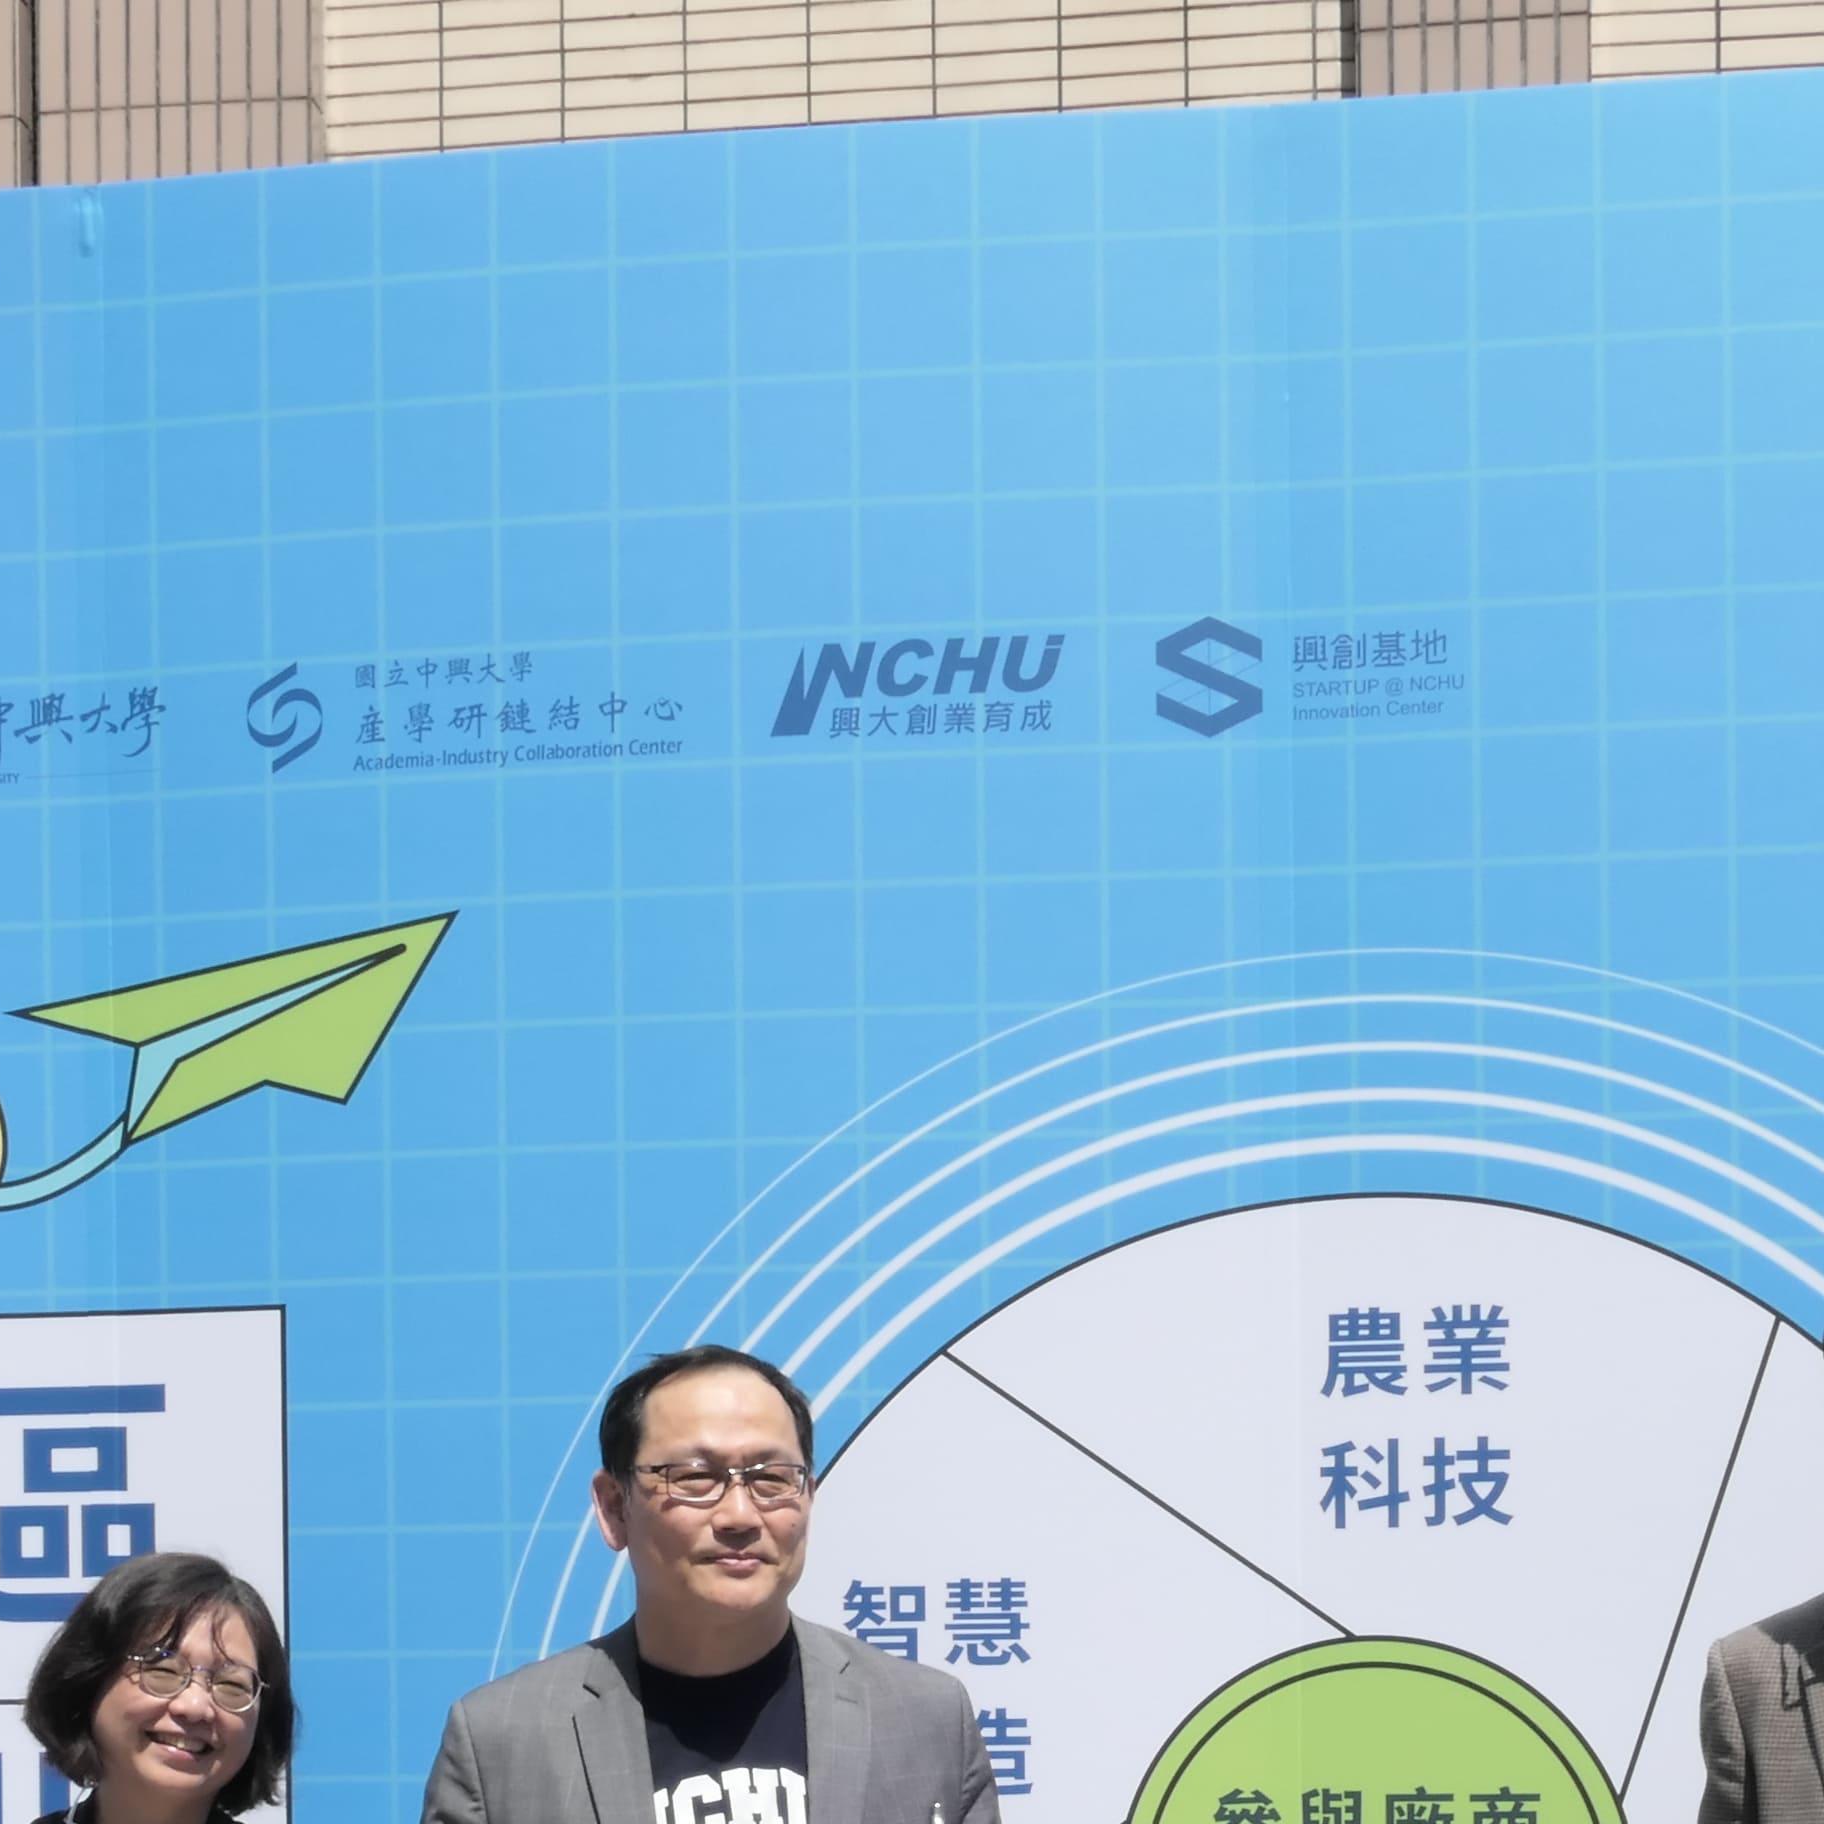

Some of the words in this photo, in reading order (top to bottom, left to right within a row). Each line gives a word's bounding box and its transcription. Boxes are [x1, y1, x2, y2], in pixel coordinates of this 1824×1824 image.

[355, 651, 534, 689] 國立中興大學
[1293, 629, 1448, 672] 興創基地
[770, 634, 1065, 737] NCHU
[1293, 679, 1380, 698] STARTUP
[1385, 677, 1404, 696] @
[1410, 674, 1465, 693] NCHU
[355, 691, 683, 744] 產學研鏈結中心
[829, 699, 1053, 740] 興大創業育成
[1293, 703, 1380, 721] Innovation
[1386, 699, 1444, 717] Center
[353, 748, 509, 772] Academia-Industry
[514, 740, 624, 763] Collaboration
[628, 737, 683, 756] Center
[1321, 1304, 1511, 1399] 農業
[1320, 1435, 1515, 1530] 科技
[843, 1577, 1032, 1666] 智慧
